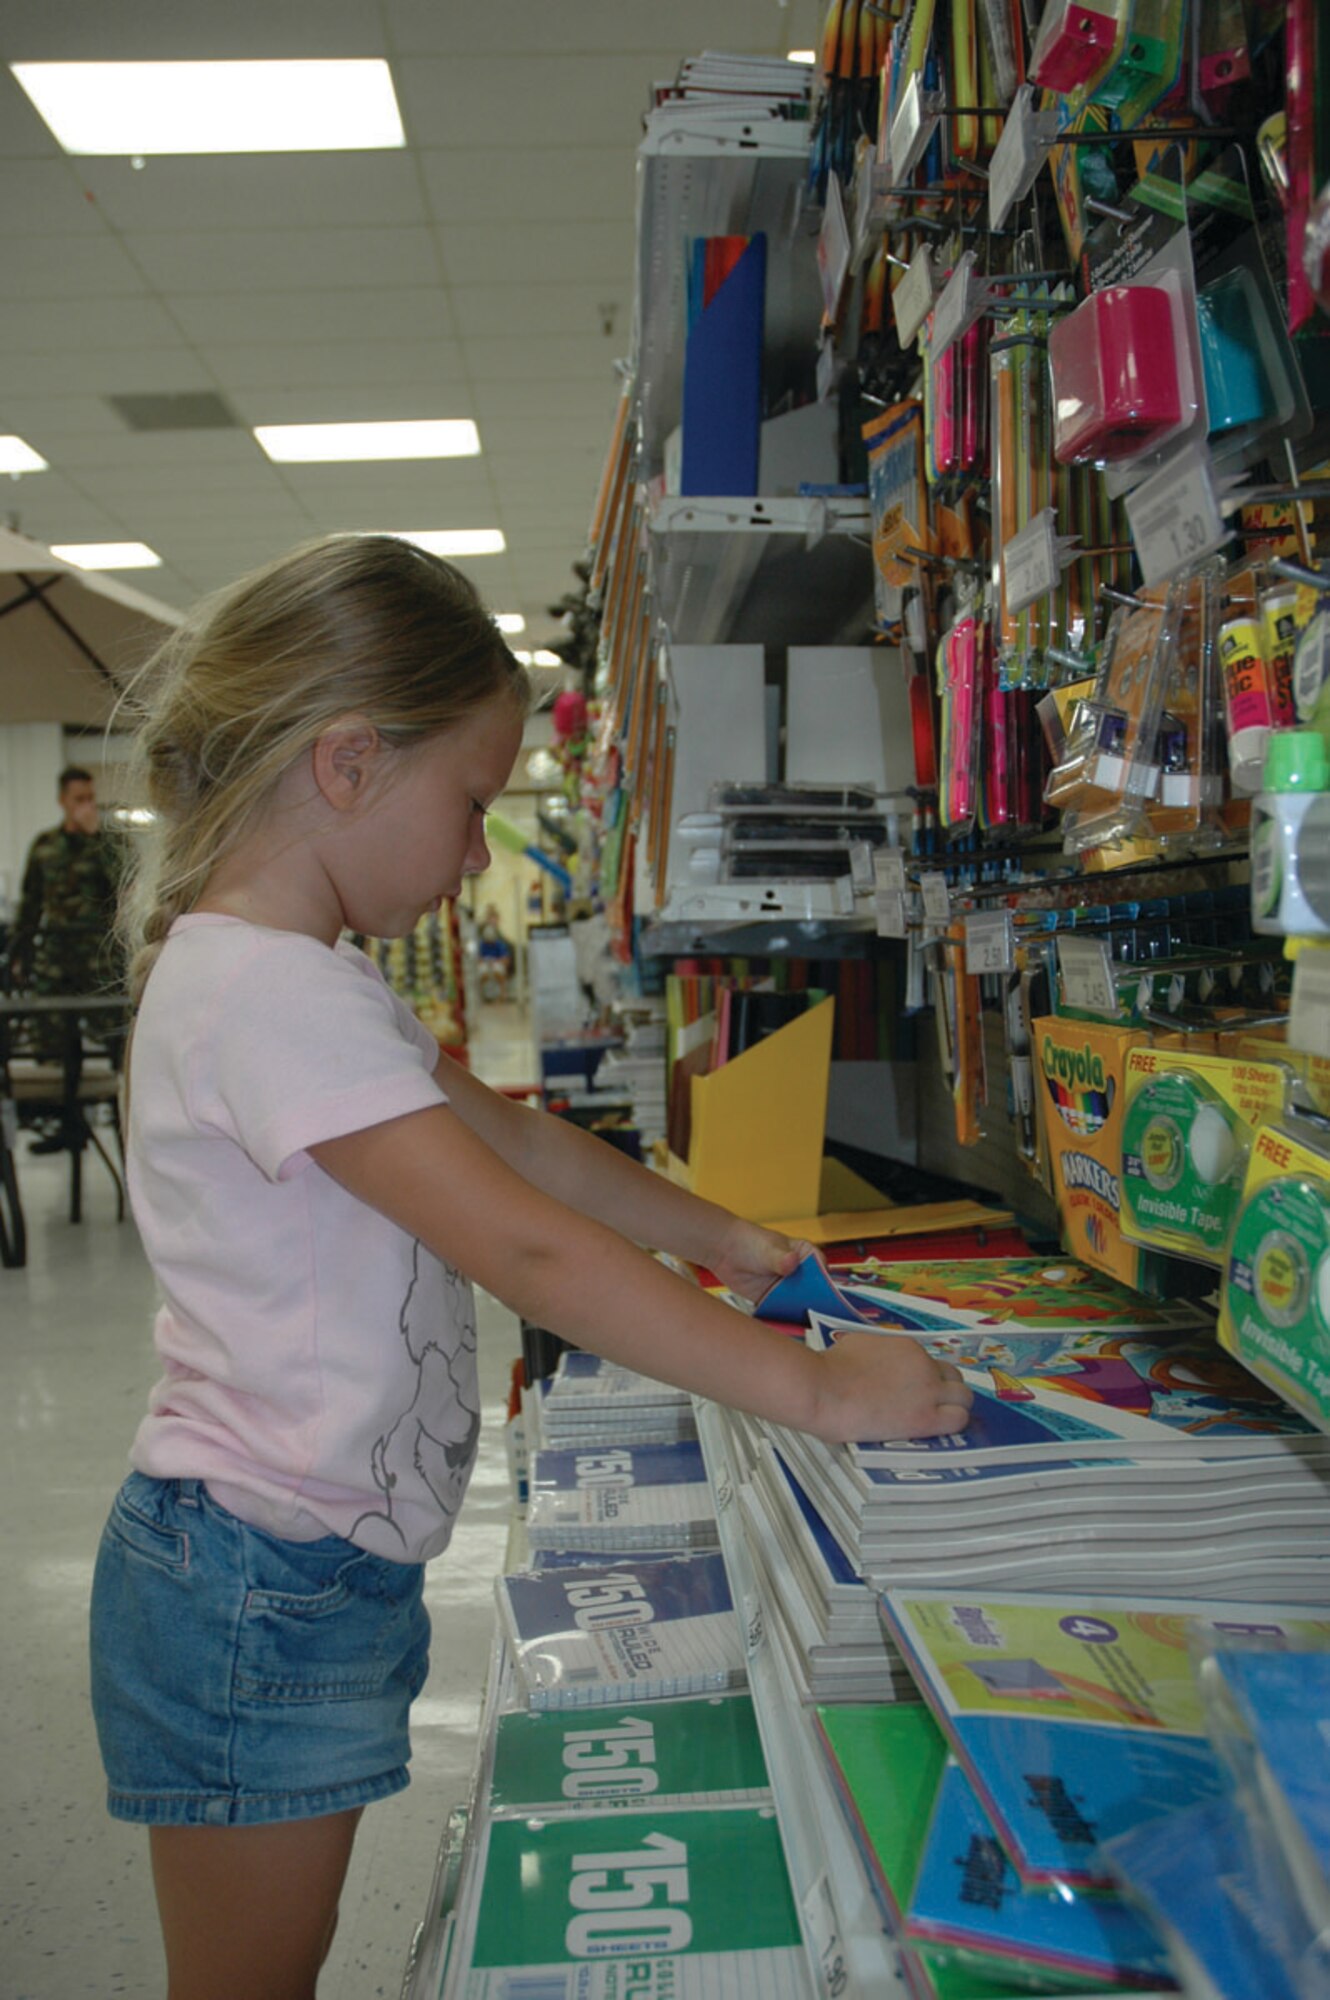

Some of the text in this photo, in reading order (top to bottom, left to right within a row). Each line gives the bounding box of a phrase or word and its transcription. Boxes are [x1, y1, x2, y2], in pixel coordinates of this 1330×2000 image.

[1043, 1034, 1106, 1091] Crayola
[1129, 1053, 1157, 1073] FREE
[1255, 1134, 1292, 1169] FREE
[1061, 1151, 1121, 1208] MARKERS
[1137, 1193, 1187, 1223] Invisible
[1241, 1314, 1304, 1374] Invisible
[576, 1449, 635, 1489] 150
[563, 1572, 655, 1632] 150
[618, 1628, 654, 1670] RULED
[1073, 1618, 1107, 1636] 4
[562, 1715, 660, 1799] 150
[565, 1831, 694, 1958] 150
